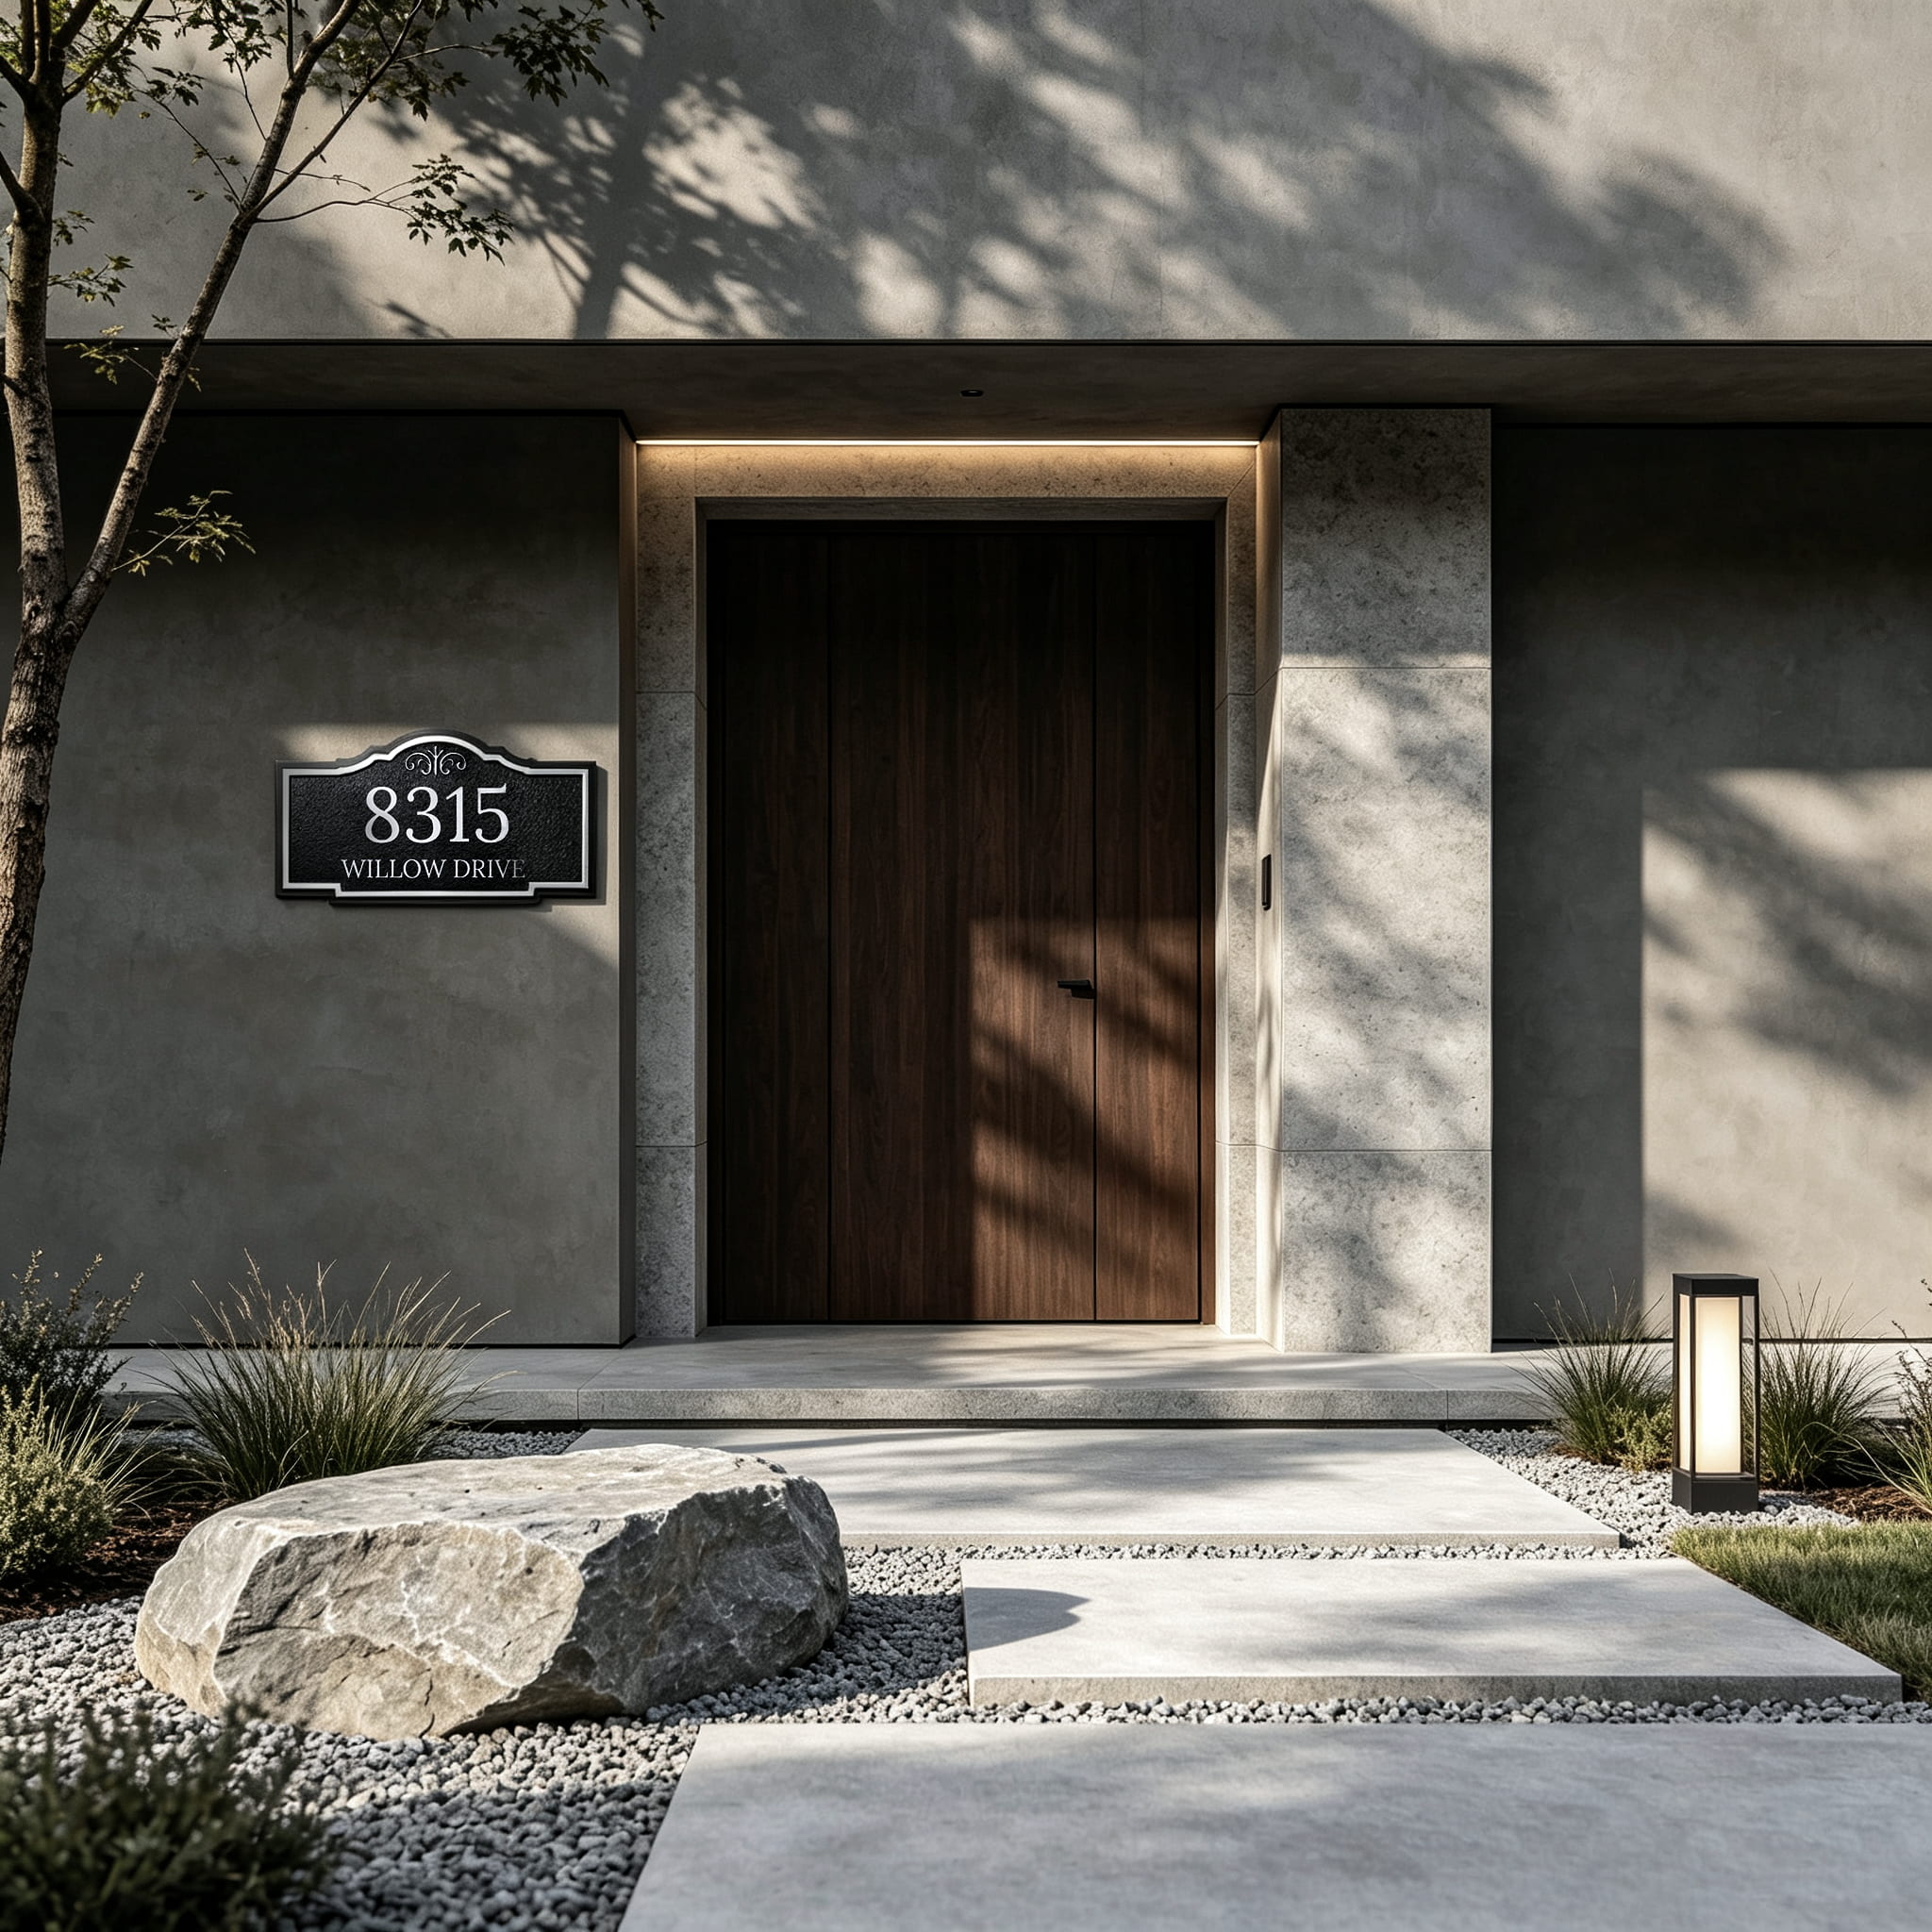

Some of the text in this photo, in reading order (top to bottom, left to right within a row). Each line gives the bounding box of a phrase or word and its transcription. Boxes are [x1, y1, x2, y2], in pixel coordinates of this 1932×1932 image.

[364, 782, 509, 843] 8315
[341, 858, 525, 878] WILLOW DRIVE
